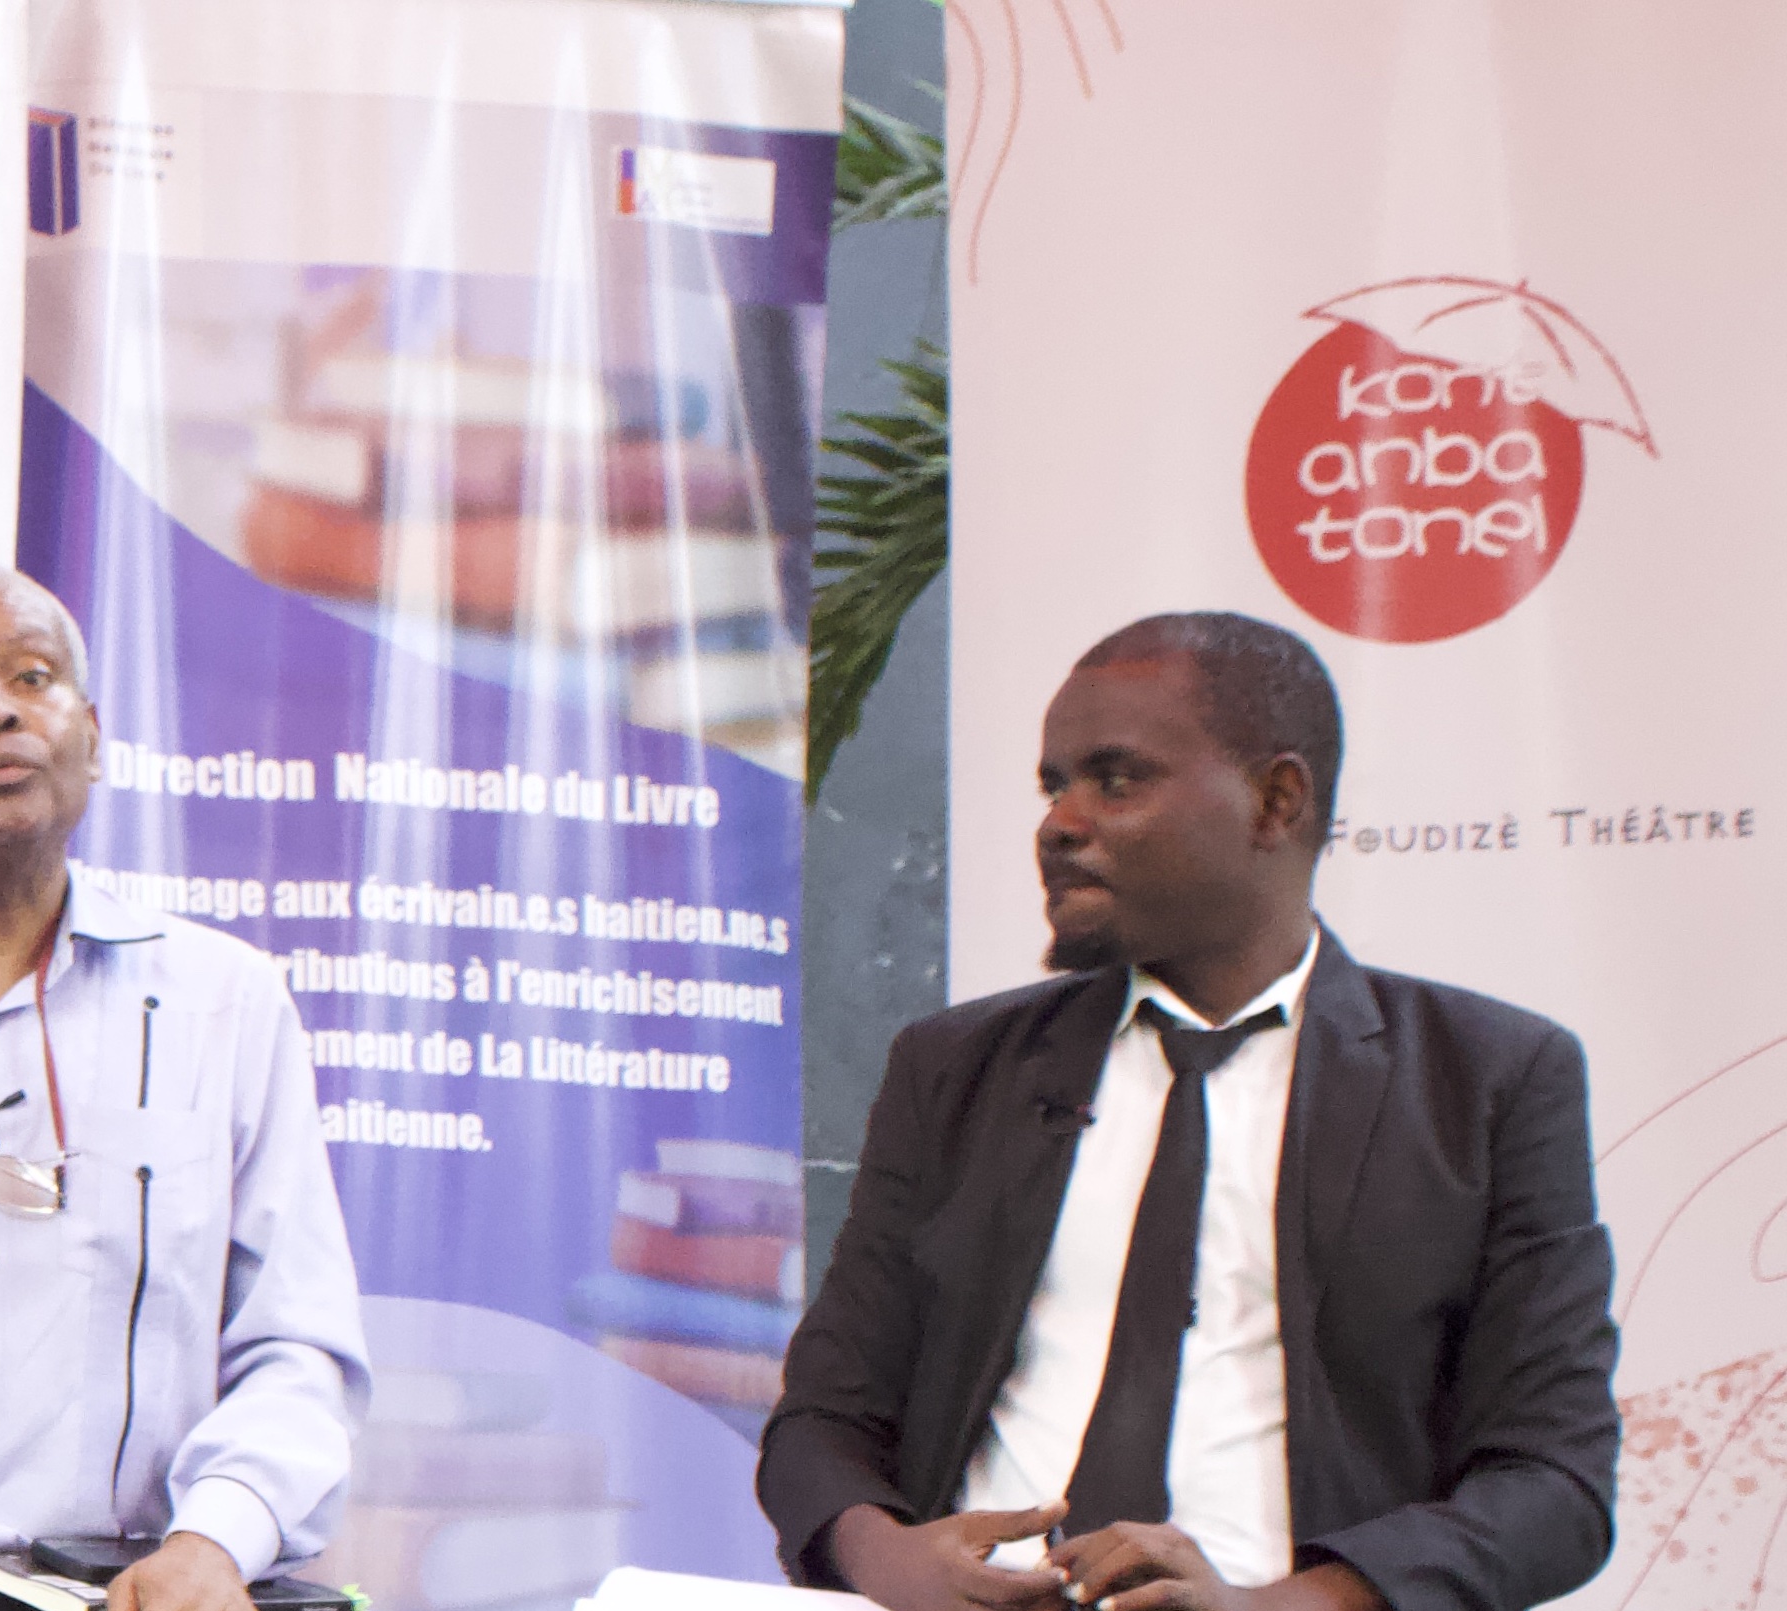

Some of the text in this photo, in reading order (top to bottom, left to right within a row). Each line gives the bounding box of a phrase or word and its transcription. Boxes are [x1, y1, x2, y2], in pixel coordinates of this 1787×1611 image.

[1297, 425, 1547, 497] anba
[1293, 493, 1548, 564] tonel
[108, 740, 721, 827] Direction Nationale du Livre
[273, 880, 352, 919] aux
[359, 875, 578, 938] écrivain.e.s
[585, 893, 791, 956] haitien.ne.s
[463, 954, 490, 1003] à
[496, 958, 784, 1028] l'enrichisement
[419, 1029, 473, 1076] de
[480, 1032, 523, 1079] La
[530, 1035, 731, 1093] Littérature
